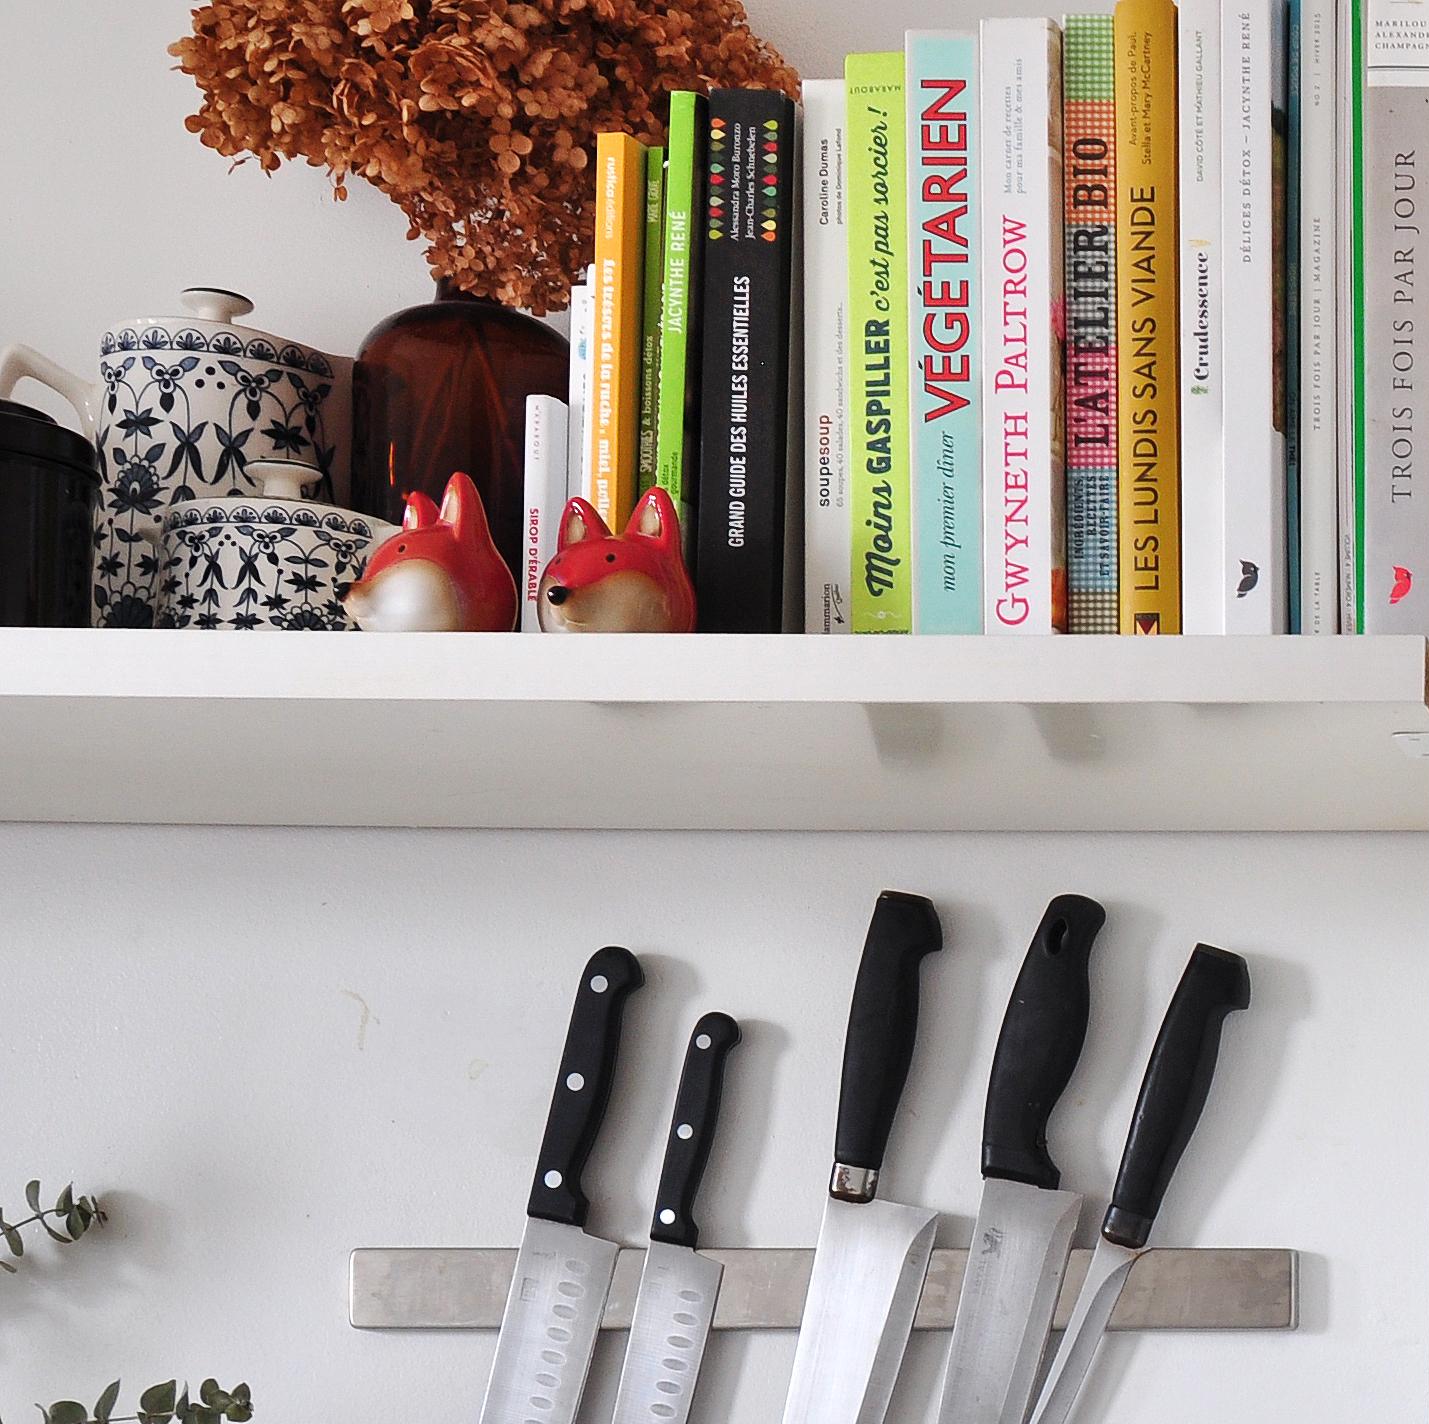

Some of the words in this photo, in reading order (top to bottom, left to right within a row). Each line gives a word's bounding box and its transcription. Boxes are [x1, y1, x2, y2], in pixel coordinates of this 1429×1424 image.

[1238, 12, 1251, 50] RENÉ
[1375, 20, 1427, 28] MARILOU
[1013, 58, 1023, 81] amis
[1127, 60, 1138, 74] de
[1140, 30, 1154, 90] McCartney
[1194, 30, 1204, 73] GALLANT
[1004, 86, 1013, 123] recettes
[1128, 76, 1139, 146] Avant-propos
[1140, 92, 1154, 120] Mary
[1195, 73, 1204, 114] MATHIEU
[1240, 56, 1251, 130] JACYNTHE
[731, 123, 741, 162] Buronzo
[1012, 117, 1023, 151] famille
[1142, 121, 1152, 133] et
[1193, 128, 1204, 152] CÔTÉ
[1195, 115, 1204, 126] ET
[745, 127, 756, 180] Schnebelen
[818, 139, 829, 177] Dumas
[1004, 140, 1012, 170] carnet
[1072, 137, 1108, 210] BIO
[1140, 135, 1152, 166] Stella
[1195, 154, 1204, 182] DAVID
[1239, 148, 1251, 196] DÉTOX
[731, 164, 740, 189] Moro
[1003, 173, 1012, 194] Mon
[1015, 171, 1025, 195] pour
[1394, 149, 1419, 235] JOUR
[730, 191, 740, 241] Alessandra
[744, 182, 756, 239] Jean-Charles
[818, 180, 829, 225] Caroline
[667, 211, 686, 252] RENÉ
[872, 211, 895, 256] pas
[917, 79, 971, 424] VÉGÉTARIEN
[1130, 185, 1157, 307] VIANDE
[1238, 202, 1252, 263] DÉLICES
[1312, 216, 1321, 282] MAGAZINE
[603, 259, 616, 284] Les
[868, 257, 891, 312] c'est
[1393, 247, 1415, 305] PAR
[602, 286, 615, 340] trésors
[667, 258, 684, 334] JACYNTHE
[1192, 252, 1210, 382] Crudessence
[1312, 298, 1322, 328] JOUR
[731, 276, 750, 371] ESSENTIELLES
[1073, 223, 1109, 447] L'ATELIER
[1312, 333, 1321, 356] PAR
[600, 363, 613, 381] la
[601, 342, 614, 362] de
[643, 335, 653, 365] détox
[1132, 316, 1158, 400] SANS
[1392, 319, 1414, 391] FOIS
[641, 368, 652, 414] boissons
[864, 319, 891, 474] GASPILLER
[1312, 360, 1321, 389] FOIS
[731, 374, 748, 423] HUILES
[1312, 394, 1321, 431] TROIS
[730, 427, 747, 453] DES
[818, 415, 833, 507] soupesoup
[937, 430, 955, 478] dîner
[1391, 407, 1413, 503] TROIS
[729, 455, 746, 498] GUIDE
[1133, 408, 1159, 525] LUNDIS
[529, 508, 539, 544] SIROP
[727, 501, 745, 547] GRAND
[937, 482, 962, 549] premier
[1085, 475, 1097, 536] RECETTES
[1098, 475, 1111, 560] SAVOIR-FAIRE
[864, 480, 901, 597] Moins
[527, 547, 539, 602] D'ÉRABLE
[941, 553, 956, 592] mon
[1099, 563, 1111, 577] ET
[1134, 536, 1160, 591] LES
[822, 584, 831, 634] lammarion
